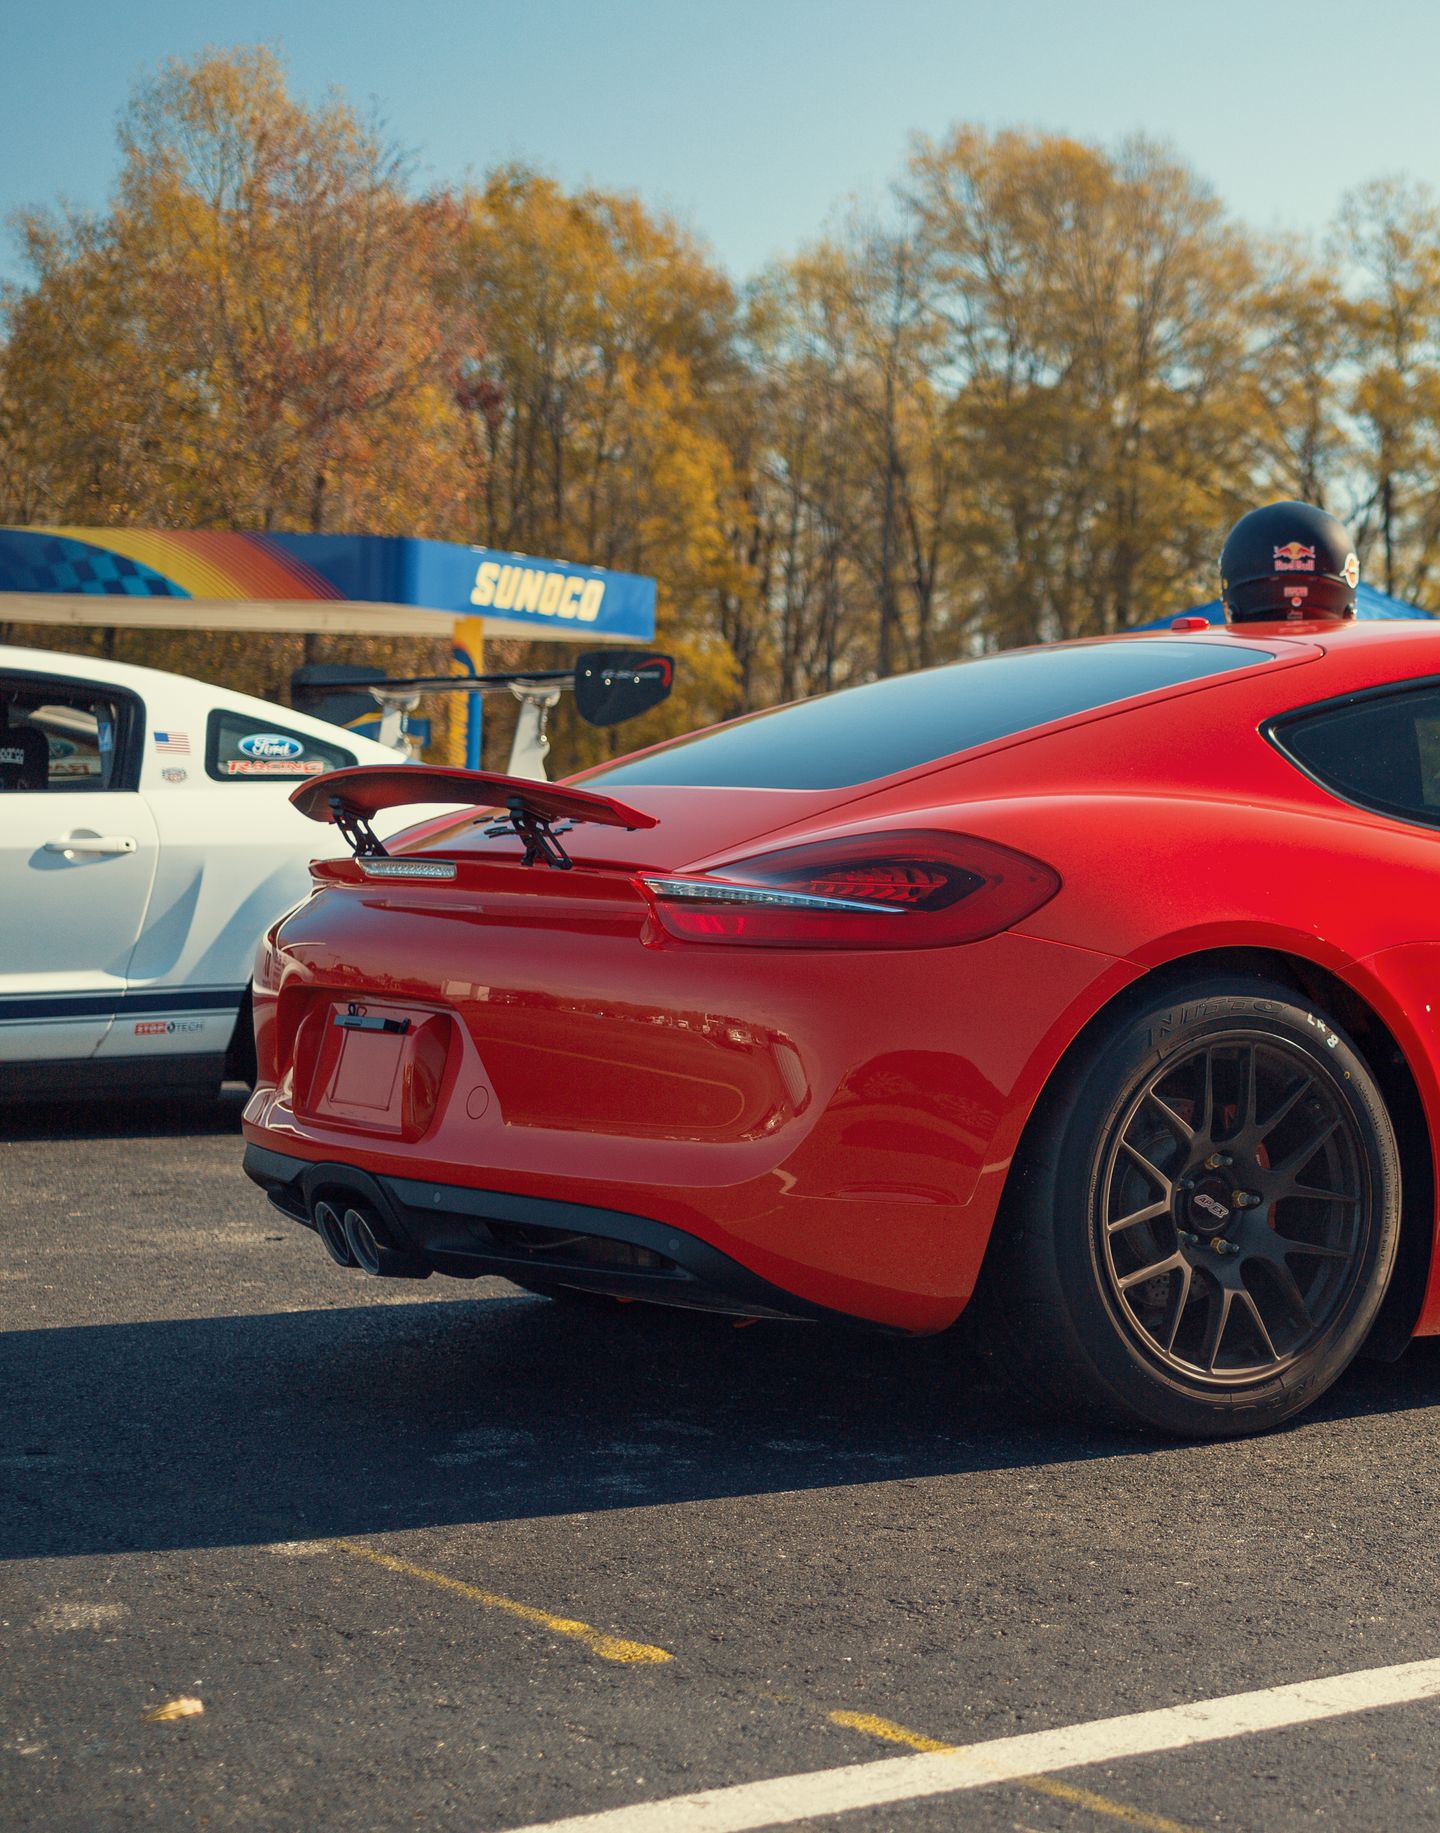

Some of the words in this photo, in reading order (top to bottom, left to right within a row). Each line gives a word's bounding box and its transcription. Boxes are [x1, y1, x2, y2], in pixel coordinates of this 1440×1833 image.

[1274, 559, 1294, 571] Red
[1295, 559, 1315, 571] Bull
[470, 561, 606, 622] SUNOCO
[251, 737, 291, 757] Ford
[227, 761, 324, 776] RACING
[1147, 998, 1285, 1046] NITTO
[1194, 1194, 1229, 1218] APEX
